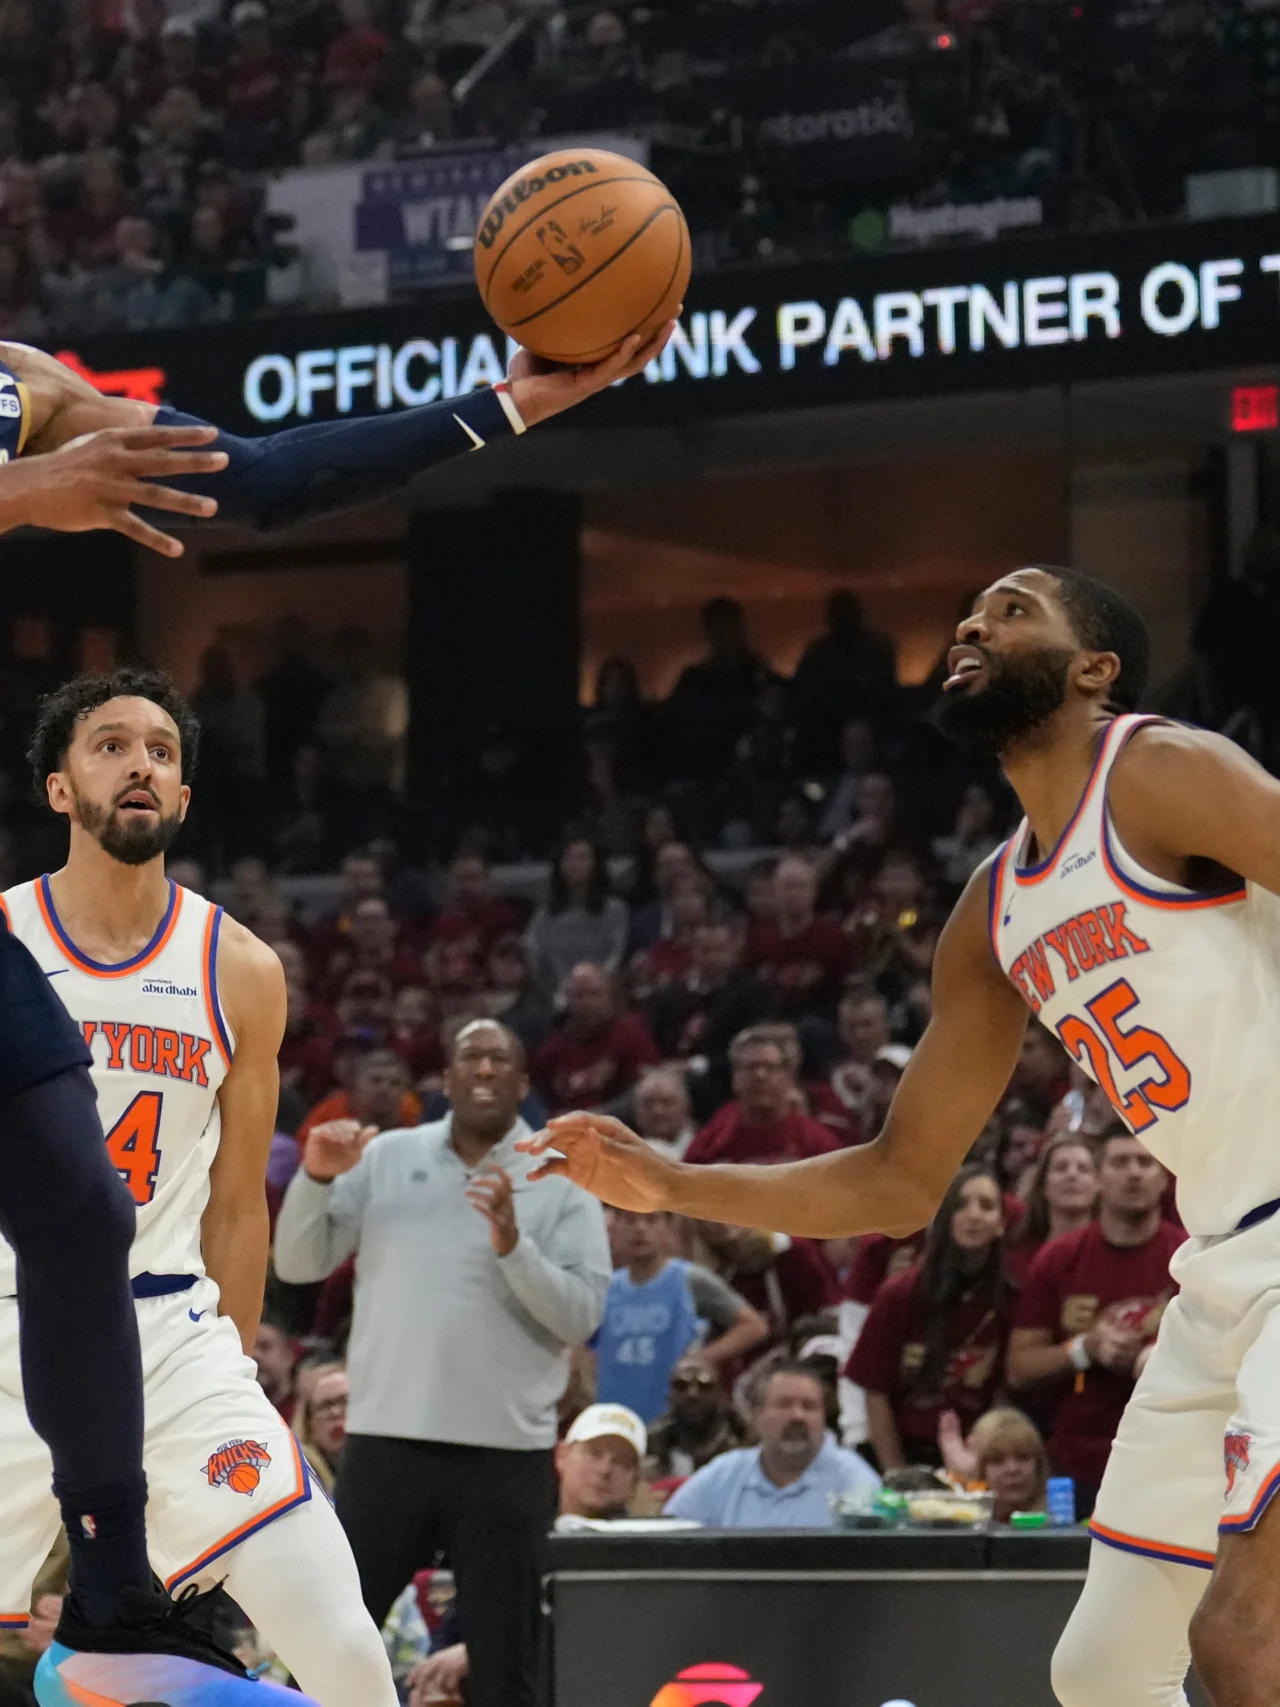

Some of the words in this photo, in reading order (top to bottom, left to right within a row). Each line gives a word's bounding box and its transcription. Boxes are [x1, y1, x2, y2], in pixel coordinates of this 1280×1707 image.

[478, 159, 598, 250] Wilson
[244, 332, 524, 422] OFFICIA
[776, 271, 1121, 371] PARTNER
[1140, 258, 1245, 336] OF
[142, 983, 164, 994] abu
[165, 985, 197, 996] dhabi
[1009, 937, 1056, 1014] EW
[1042, 899, 1152, 983] YORK
[100, 1021, 212, 1089] YORK
[1054, 976, 1192, 1136] 25
[207, 1440, 272, 1486] KNICKS
